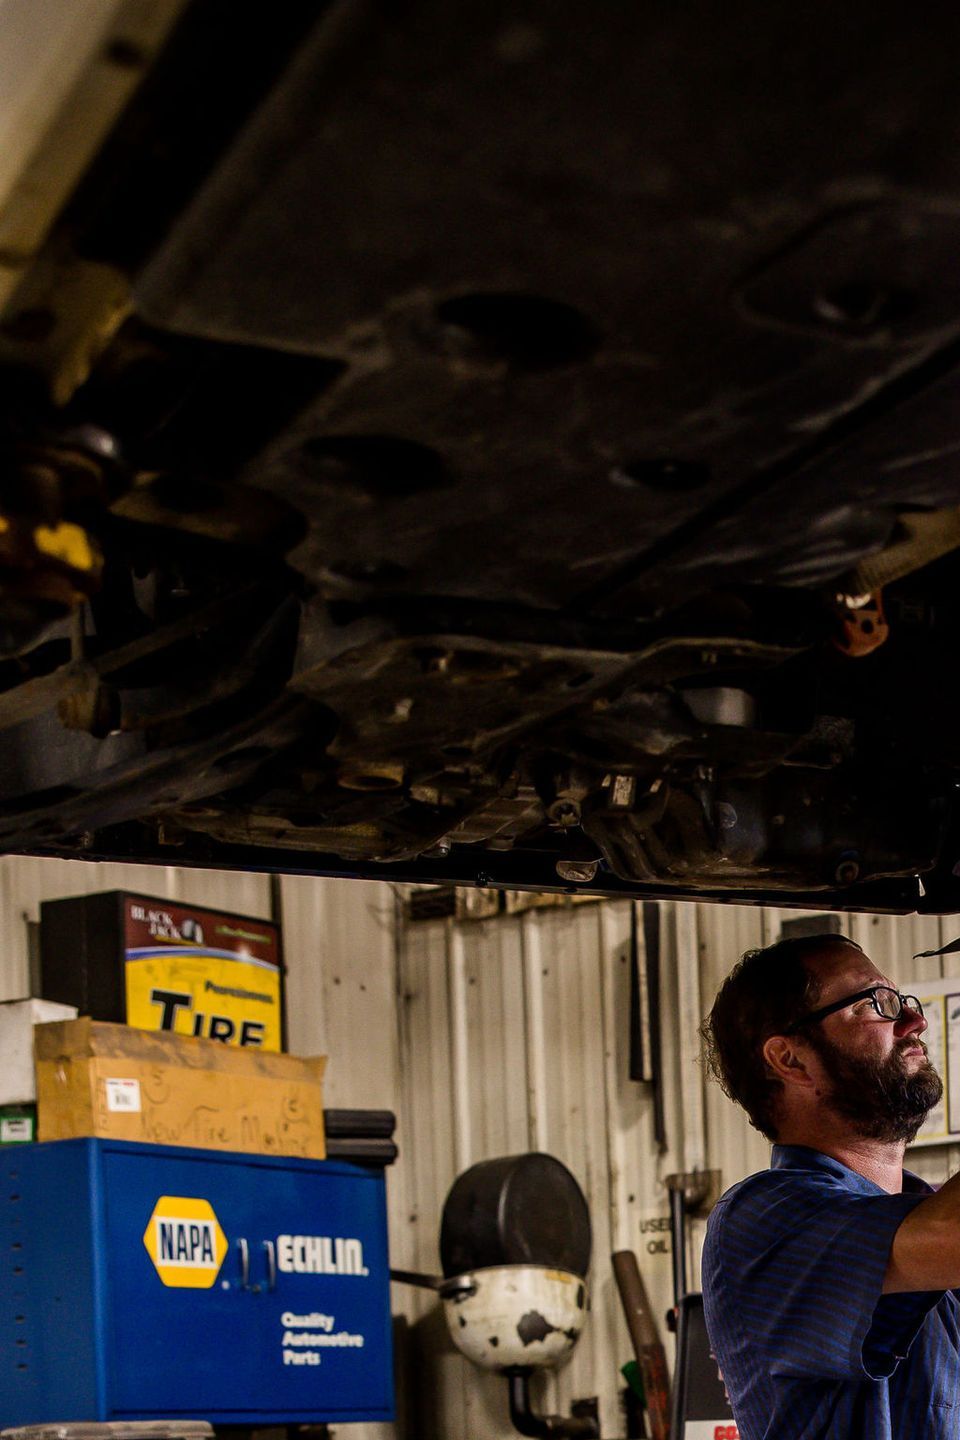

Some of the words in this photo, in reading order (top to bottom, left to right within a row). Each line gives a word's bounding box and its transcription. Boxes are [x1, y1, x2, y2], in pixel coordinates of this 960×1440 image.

[160, 1223, 214, 1262] NAPA
[281, 1311, 335, 1332] Quality
[282, 1331, 364, 1348] Automotive
[283, 1350, 321, 1366] Parts
